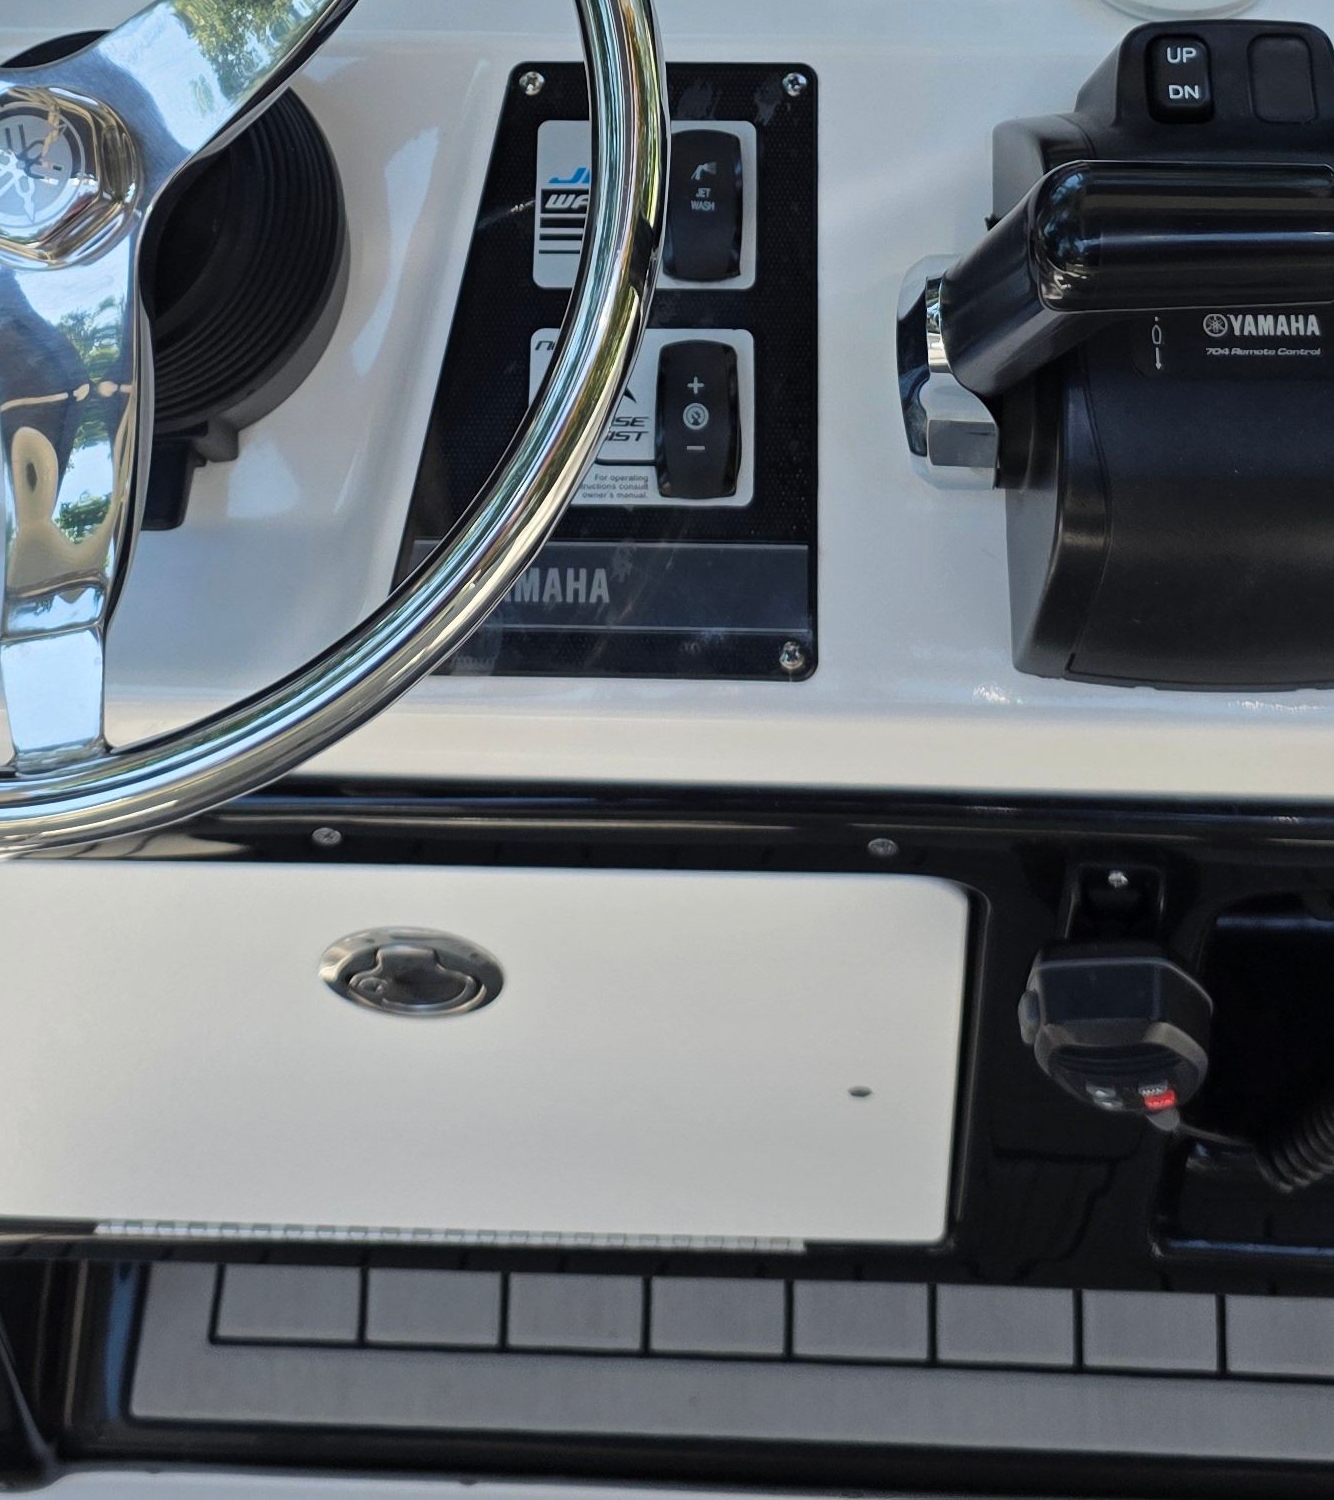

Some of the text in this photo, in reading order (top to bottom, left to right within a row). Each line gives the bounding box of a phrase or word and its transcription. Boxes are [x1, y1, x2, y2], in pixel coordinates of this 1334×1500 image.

[1166, 47, 1197, 64] UP
[1168, 84, 1200, 100] DN
[695, 187, 712, 198] JET
[690, 200, 716, 212] WASH
[1227, 314, 1321, 336] YAMAHA
[1205, 347, 1321, 356] 704 Remote Control
[609, 474, 649, 483] operating
[505, 567, 611, 604] MAHA
